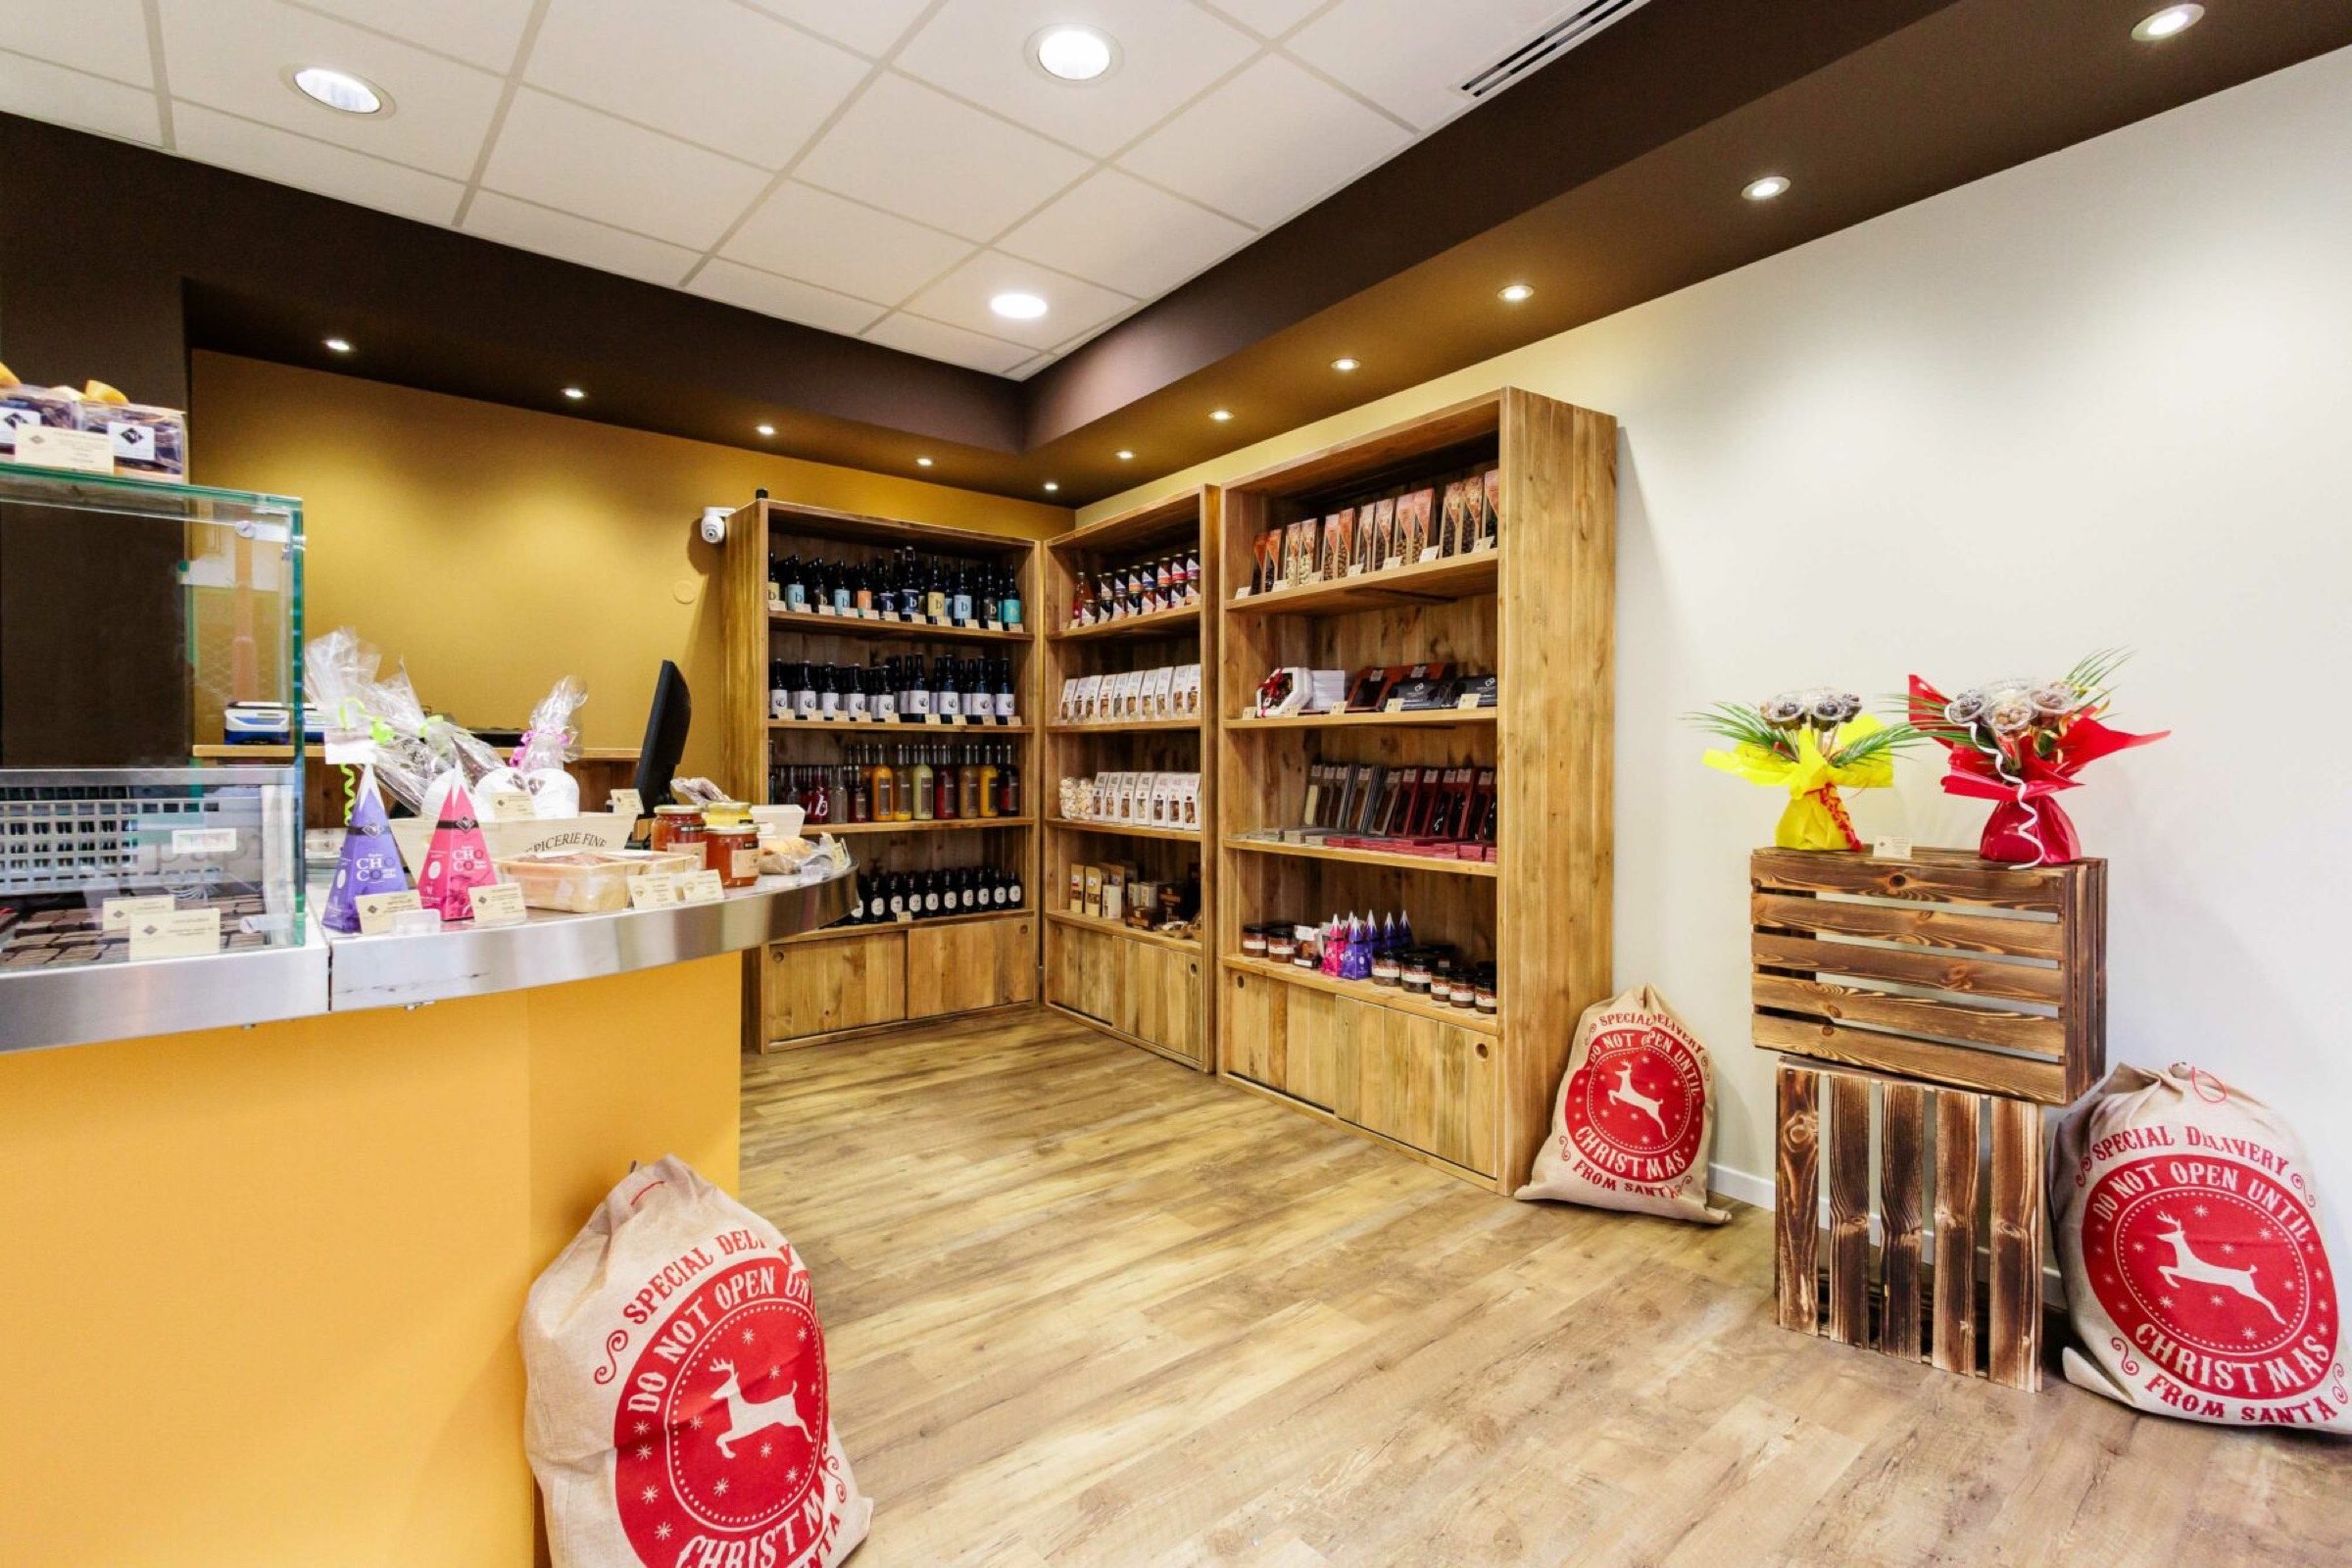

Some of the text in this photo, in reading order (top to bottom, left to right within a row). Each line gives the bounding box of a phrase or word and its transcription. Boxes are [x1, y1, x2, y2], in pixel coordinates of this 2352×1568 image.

[1599, 1013, 1653, 1027] SPECIAL
[1602, 1033, 1635, 1049] NOT
[1674, 1049, 1701, 1097] UNTIL
[1575, 1125, 1687, 1180] CHRISTMAS
[2092, 1126, 2176, 1161] SPECIAL
[1572, 1159, 1617, 1191] FROM
[2092, 1161, 2313, 1243] DO NOT OPEN UNTIL
[623, 1247, 714, 1325] SPECIAL
[626, 1266, 775, 1414] DO NOT OPEN
[2135, 1322, 2330, 1394] CHRISTMAS
[2144, 1372, 2338, 1424] FROM SANTA
